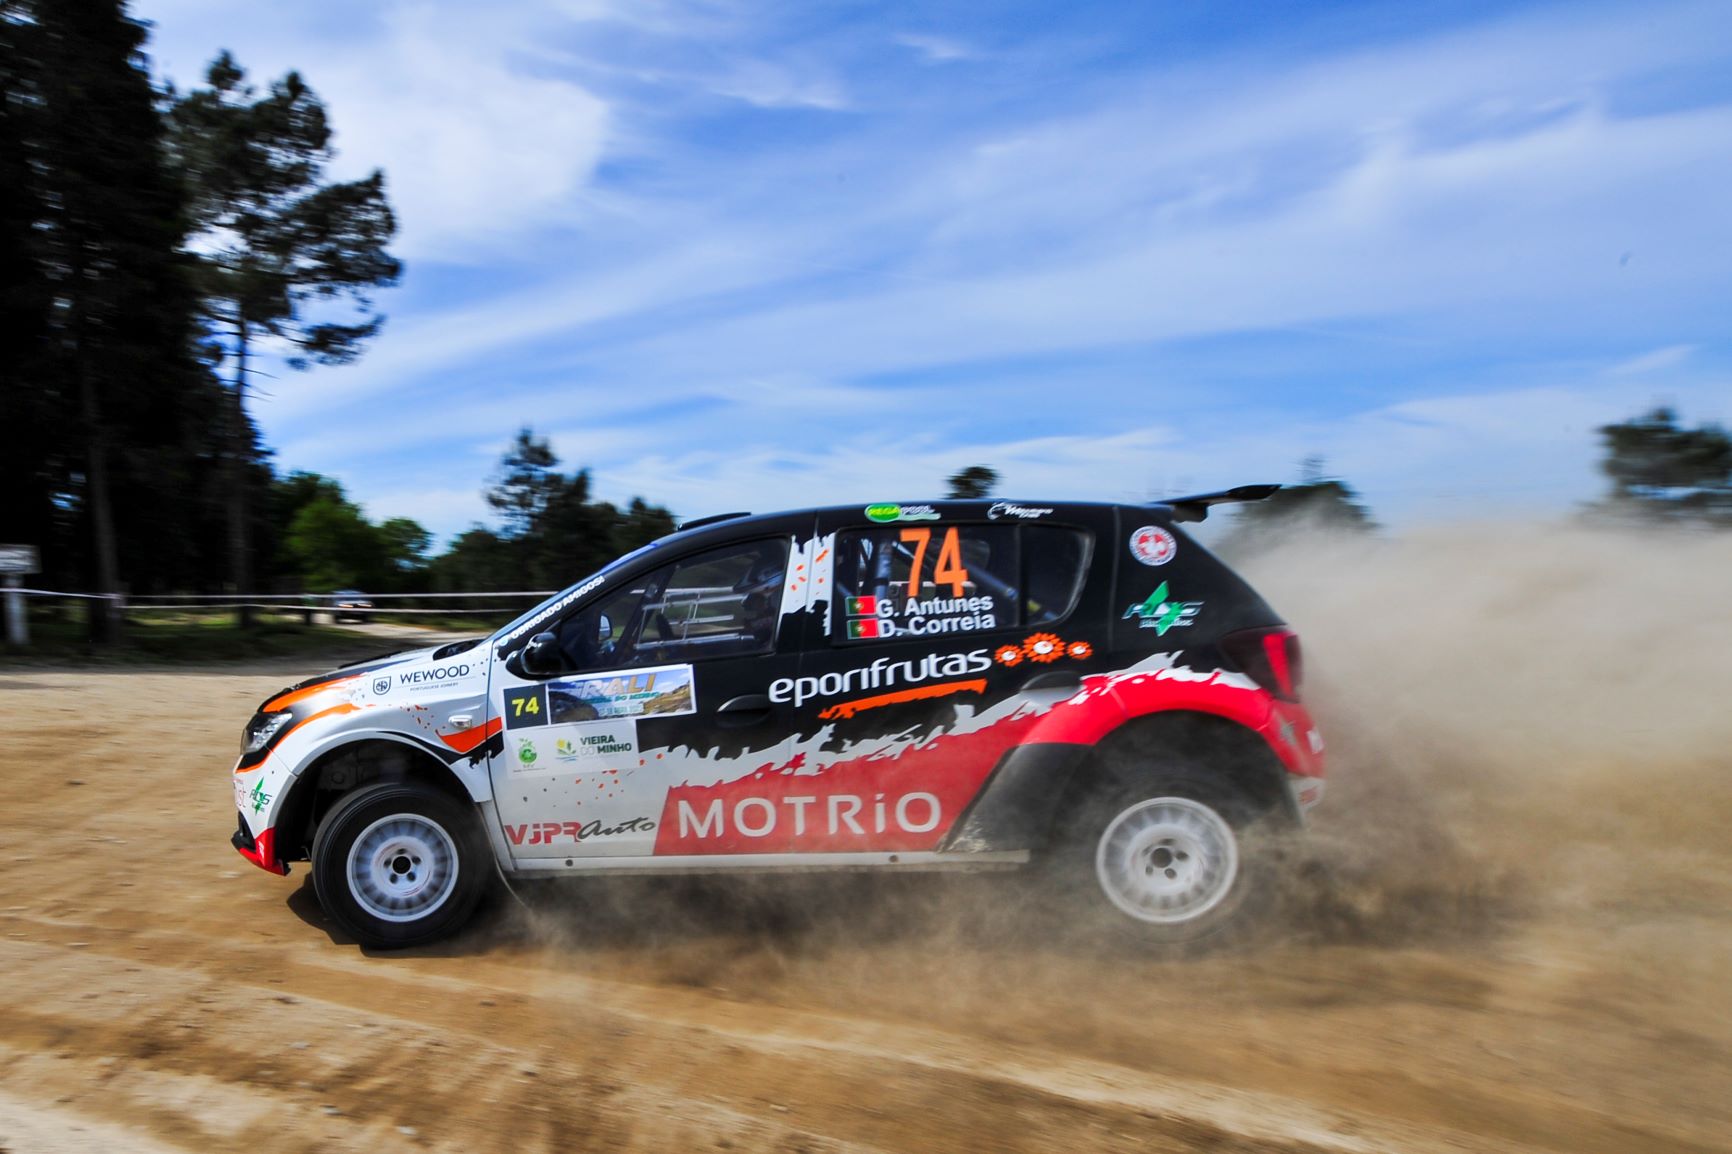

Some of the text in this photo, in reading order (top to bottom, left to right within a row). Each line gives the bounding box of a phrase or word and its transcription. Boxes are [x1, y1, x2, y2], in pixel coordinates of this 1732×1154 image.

[900, 527, 968, 597] 74
[876, 595, 993, 618] G. Antunes
[879, 611, 996, 637] D. Correia
[400, 664, 470, 684] WEWOOD
[581, 673, 657, 699] RALI
[512, 696, 540, 717] 74
[580, 734, 615, 746] VIEIRA
[597, 742, 632, 754] MINHO
[677, 791, 941, 839] MOTRiO
